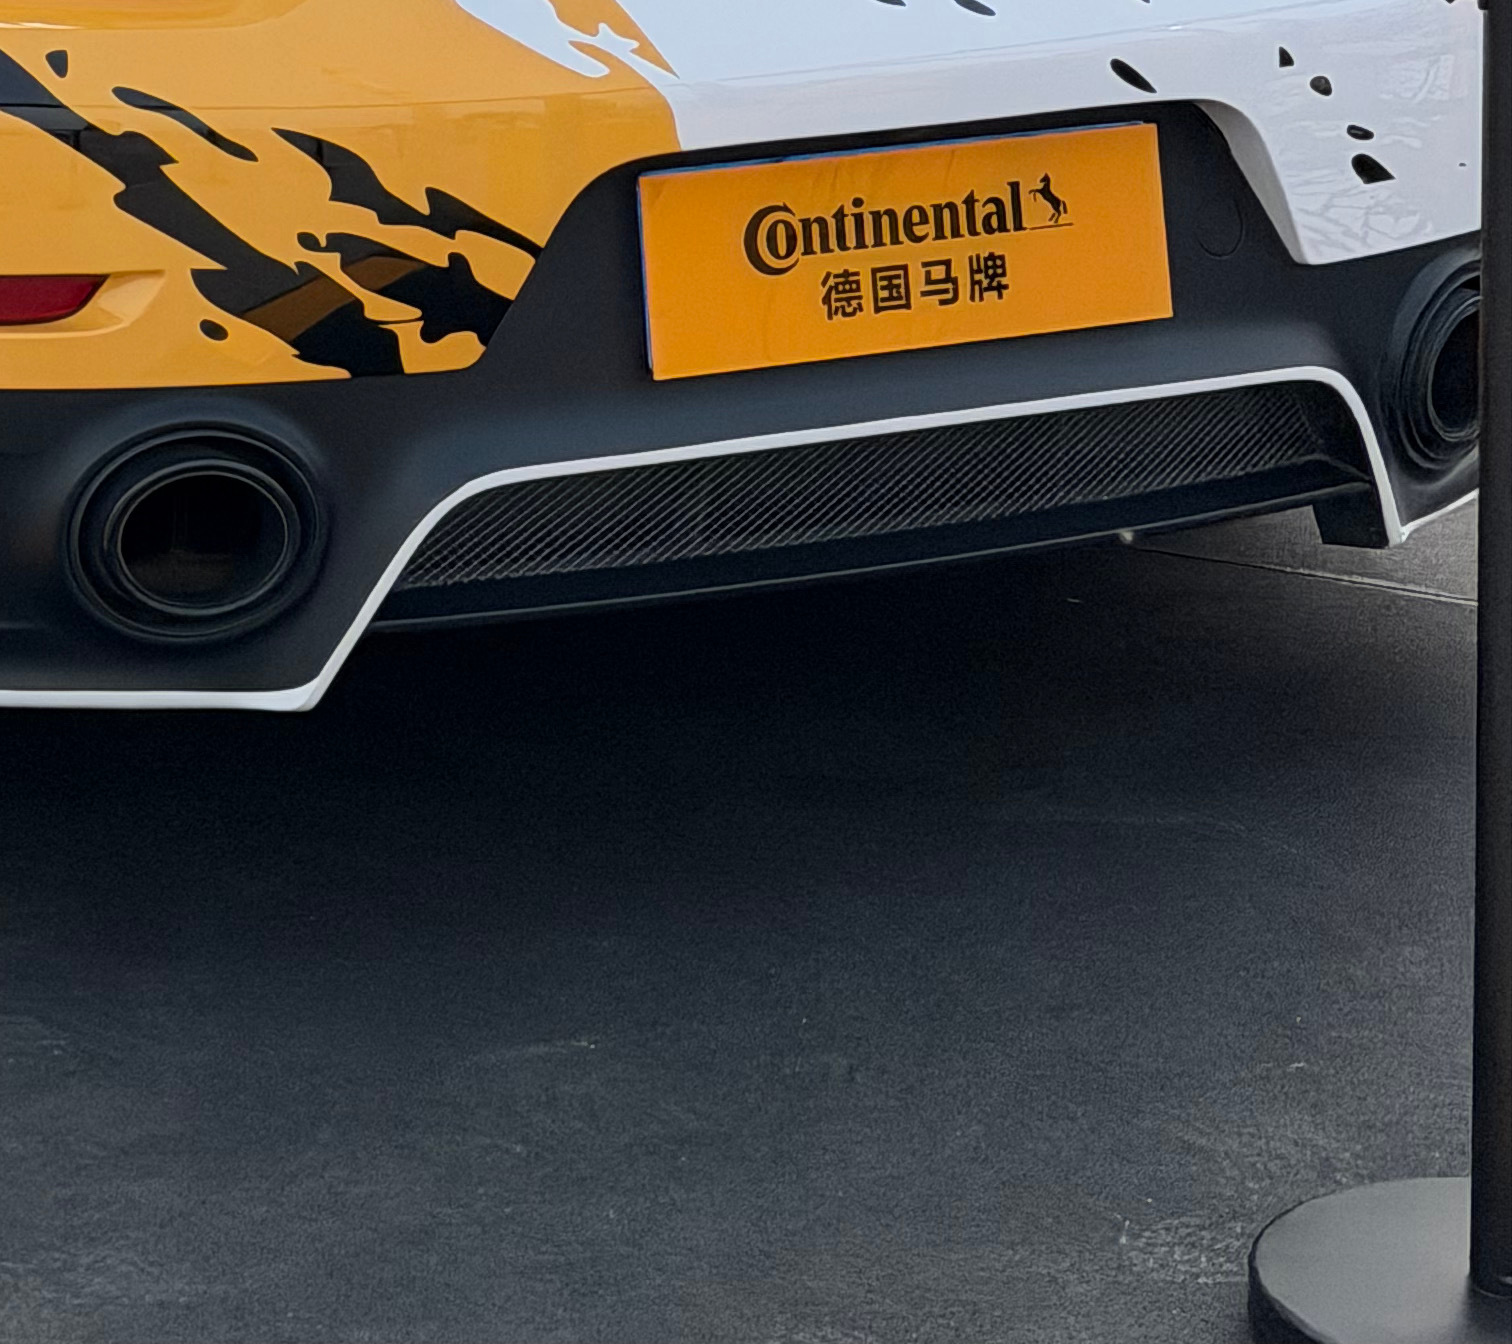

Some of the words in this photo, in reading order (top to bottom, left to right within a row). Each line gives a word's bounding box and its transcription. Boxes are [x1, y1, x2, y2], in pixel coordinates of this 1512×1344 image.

[744, 180, 1028, 276] Continental
[820, 252, 1010, 321] 德国马牌
